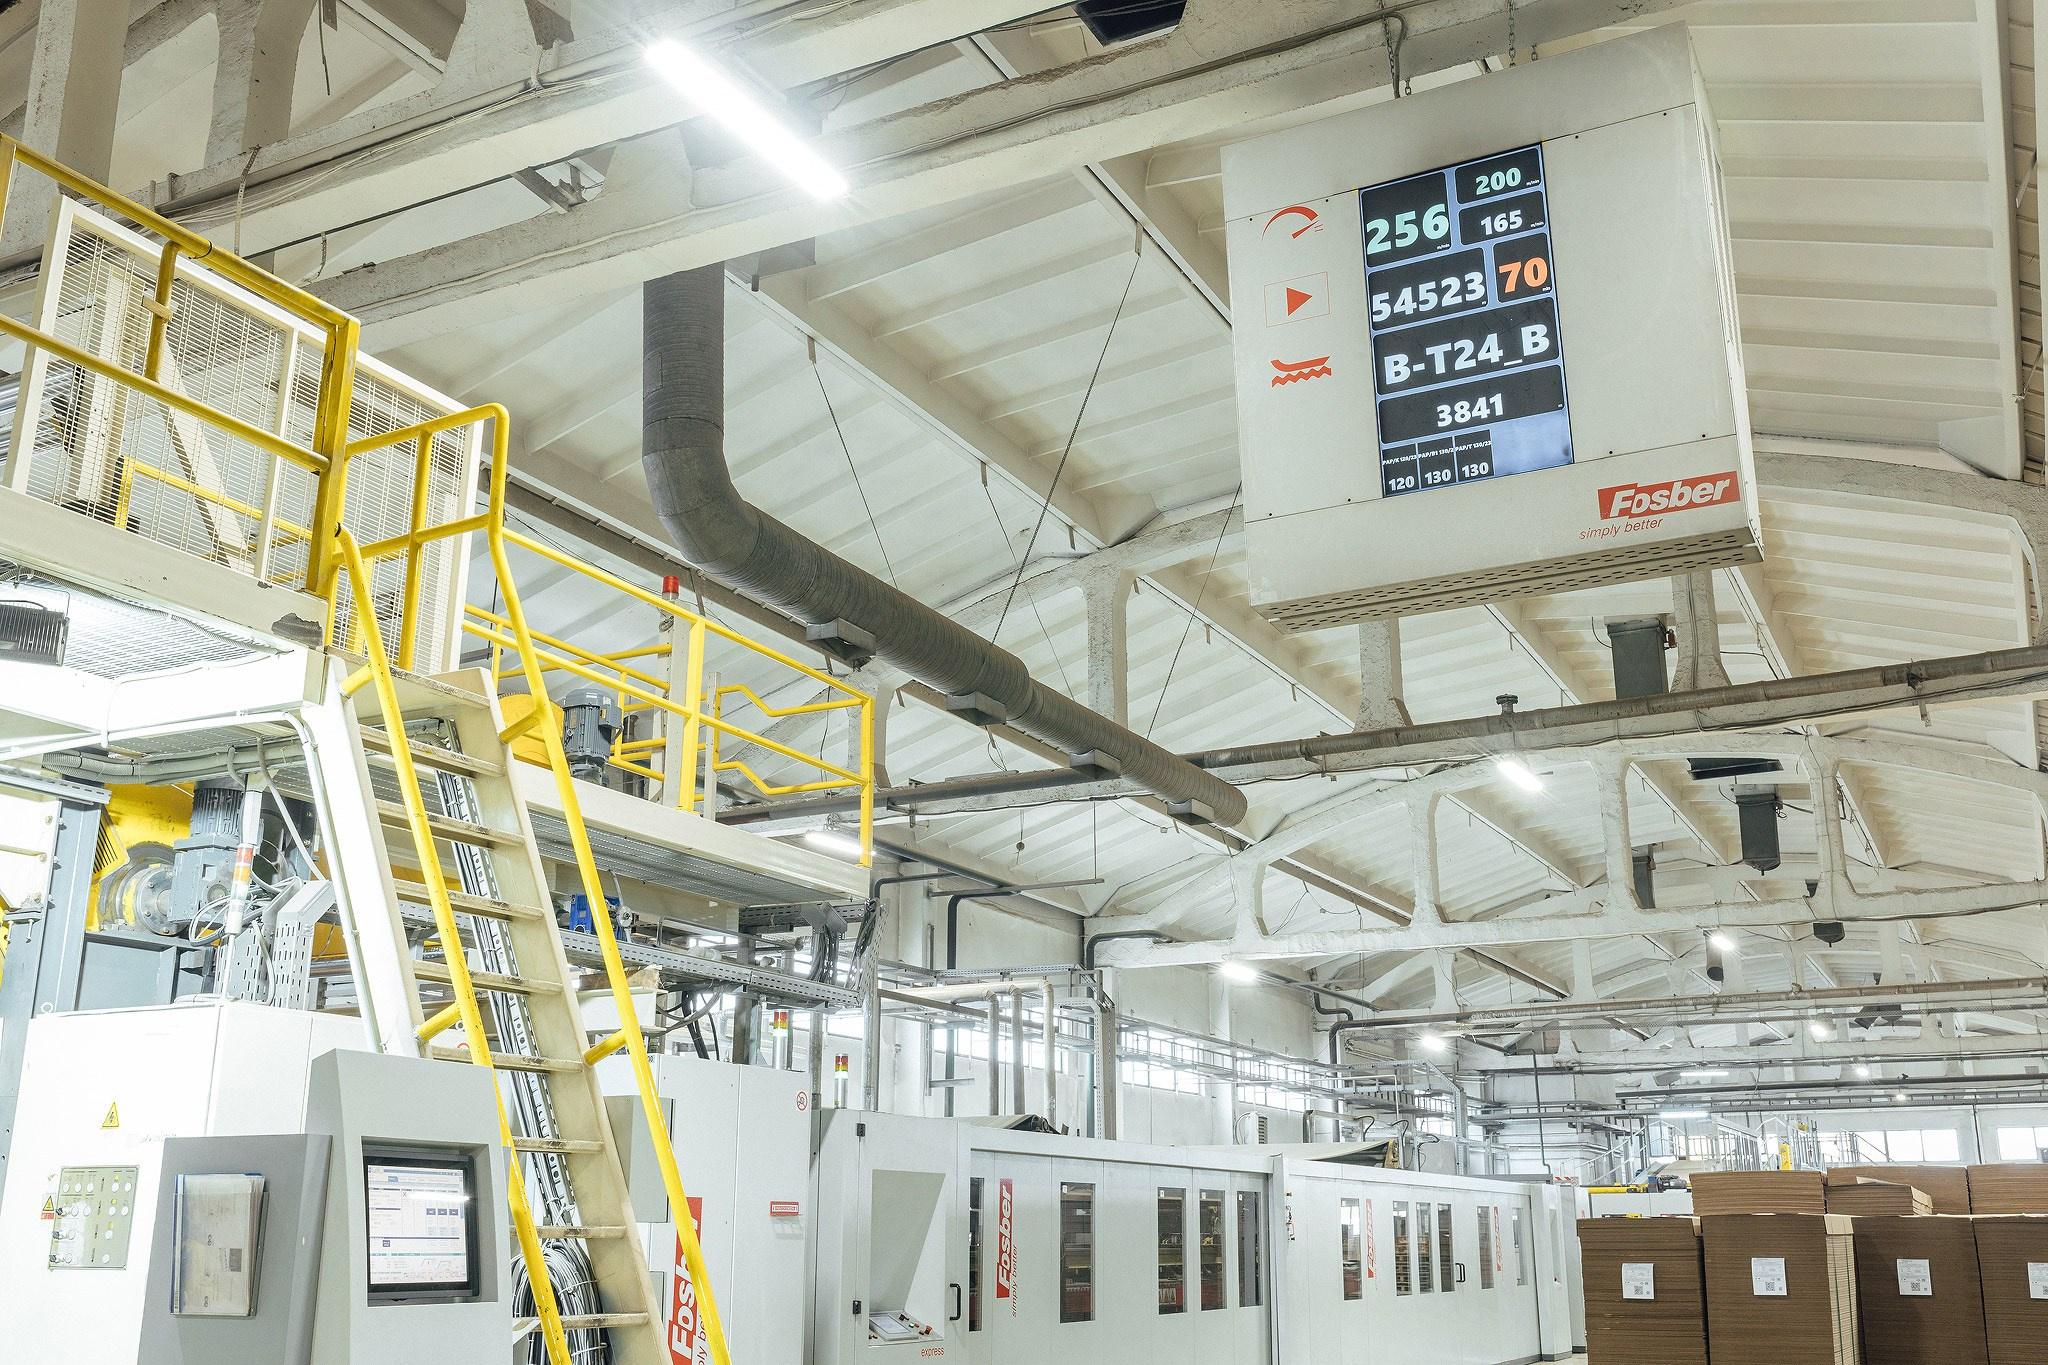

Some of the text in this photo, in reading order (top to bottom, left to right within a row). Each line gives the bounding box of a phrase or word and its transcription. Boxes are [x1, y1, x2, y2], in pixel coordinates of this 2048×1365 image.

[1475, 168, 1521, 195] 200
[1366, 204, 1450, 255] 256
[1480, 210, 1523, 235] 165
[1498, 257, 1548, 293] 70
[1372, 271, 1486, 322] 54523
[1384, 324, 1550, 385] B-T24_B
[1436, 393, 1504, 428] 3841
[1388, 475, 1415, 491] 120
[1424, 469, 1452, 484] 130
[1462, 462, 1489, 478] 130
[1609, 479, 1730, 518] Fosber
[1578, 518, 1664, 540] simply better
[998, 1184, 1012, 1290] Fosber
[920, 1347, 945, 1358] express
